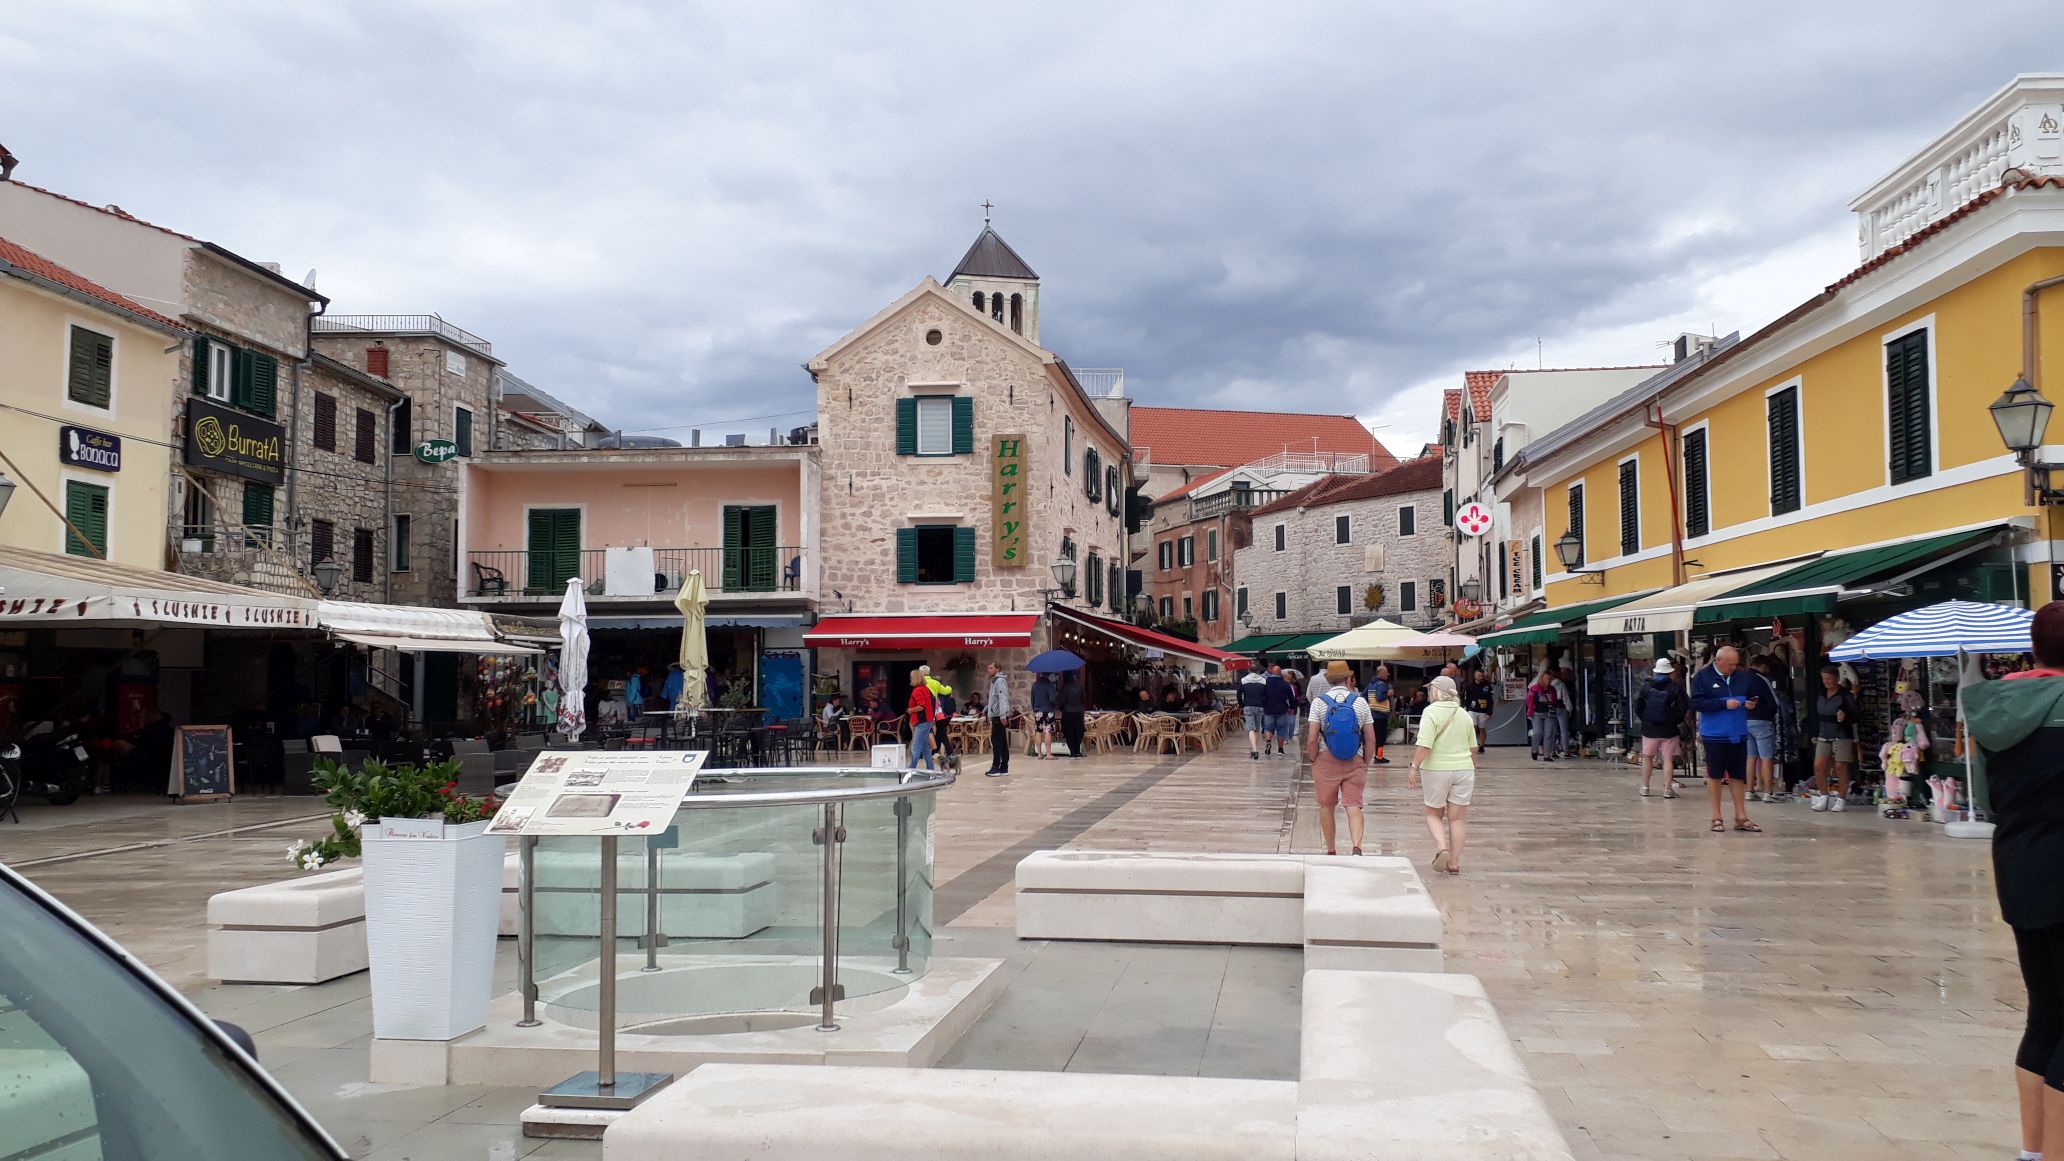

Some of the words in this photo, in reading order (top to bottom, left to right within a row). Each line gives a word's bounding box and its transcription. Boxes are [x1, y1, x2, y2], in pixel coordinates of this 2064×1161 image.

[152, 600, 218, 620] SLUSHIE
[244, 607, 300, 624] SLUSHIE
[840, 638, 870, 647] Harry's
[964, 637, 993, 646] Harry's
